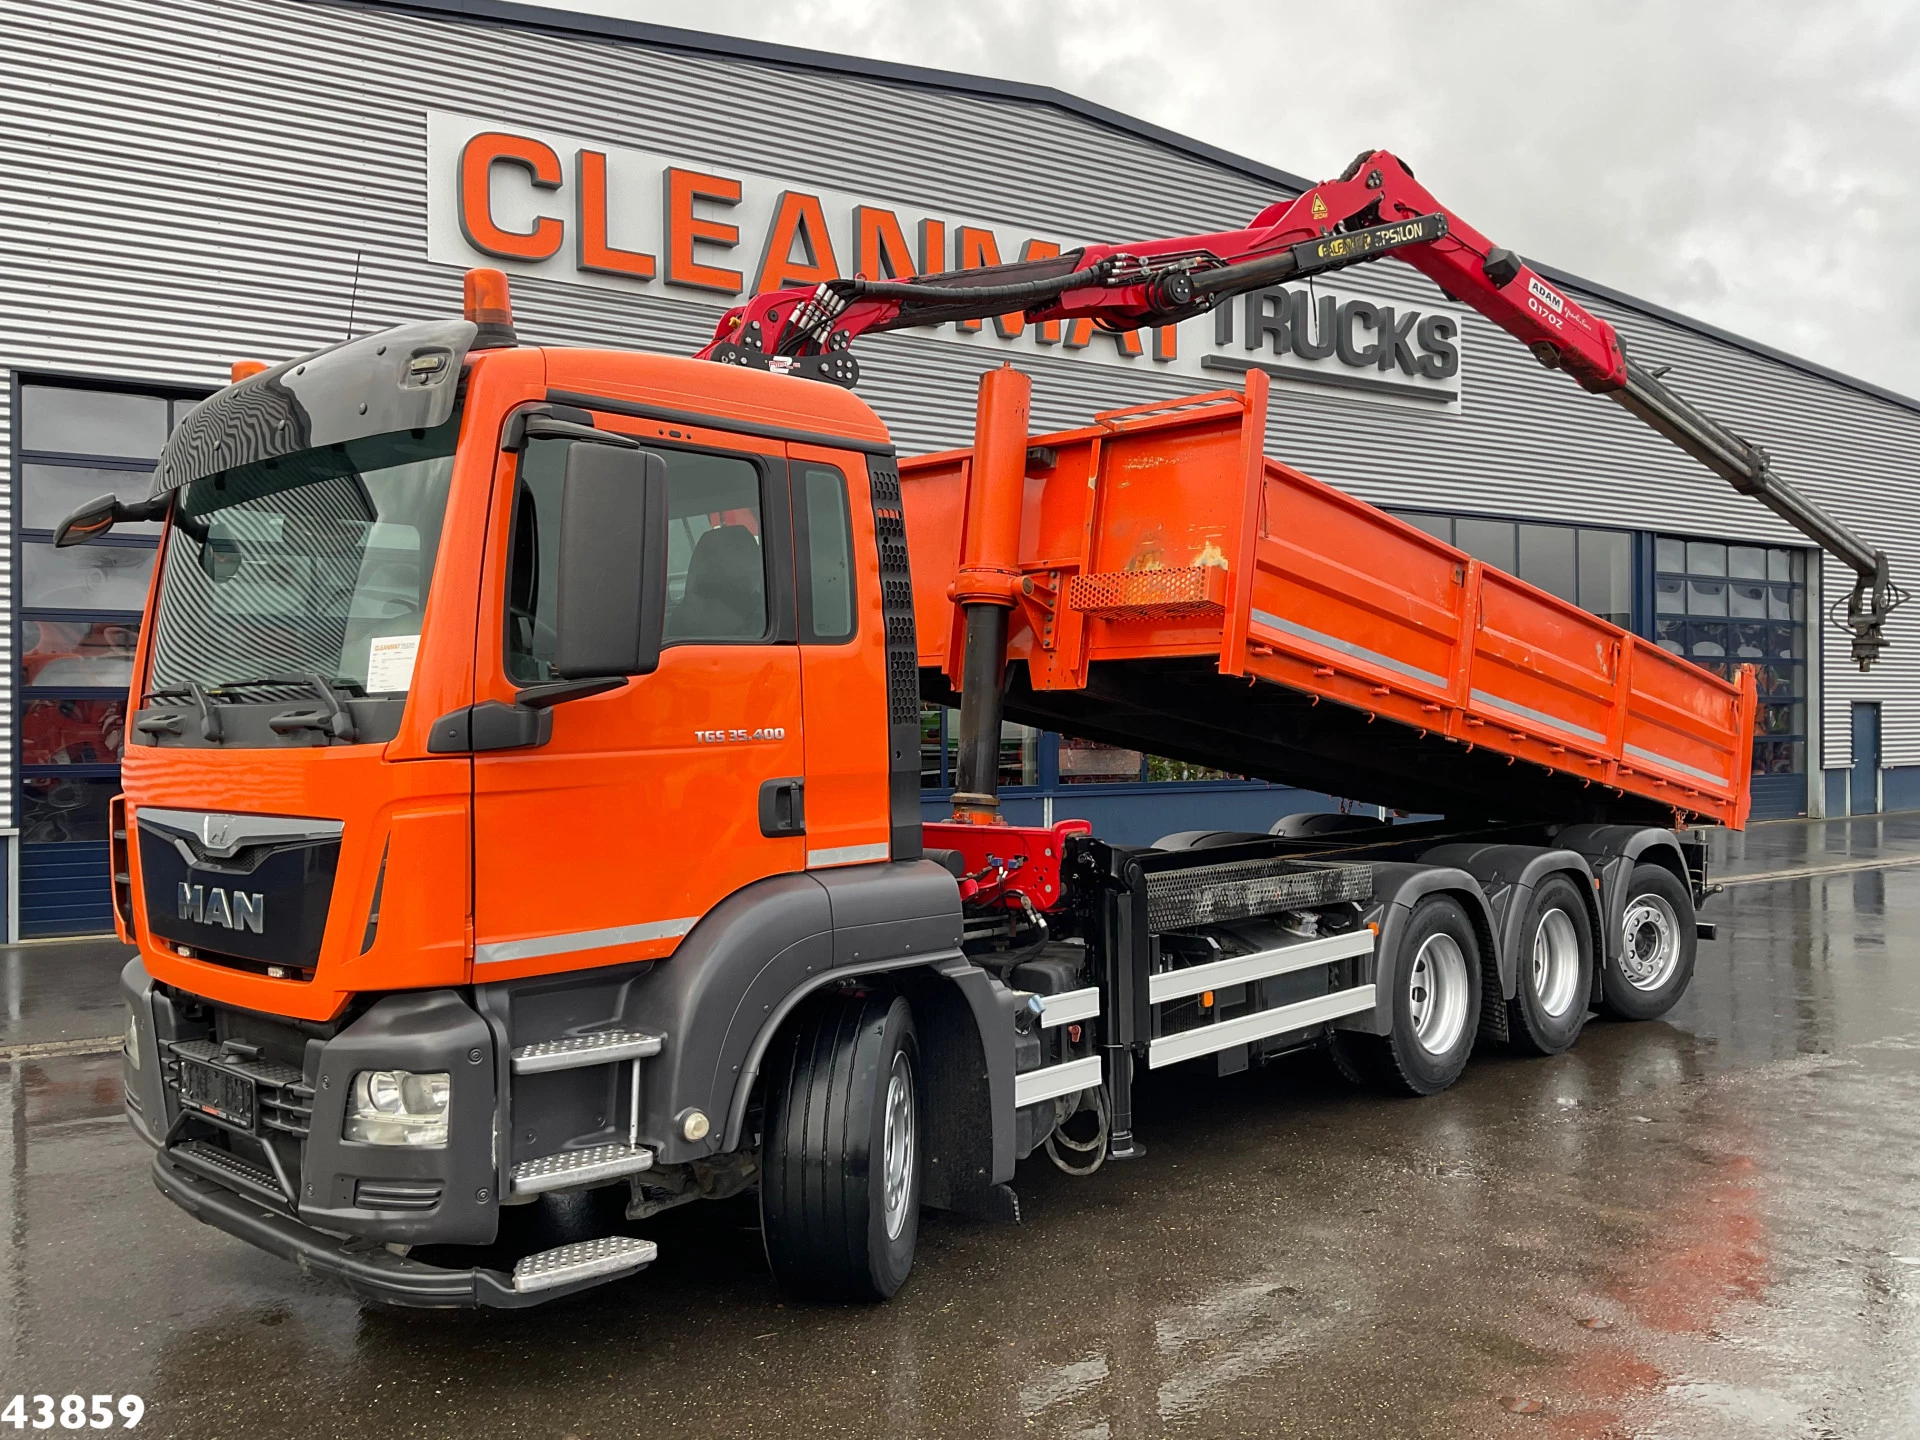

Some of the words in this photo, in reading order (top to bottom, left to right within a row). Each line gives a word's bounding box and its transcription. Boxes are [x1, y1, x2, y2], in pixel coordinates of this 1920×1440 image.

[457, 131, 1178, 362] CLEANM
[1532, 282, 1562, 308] ADAM
[1528, 297, 1564, 330] Q170Z
[694, 730, 726, 743] TGS
[728, 727, 785, 742] 35.400
[177, 881, 264, 934] MAN
